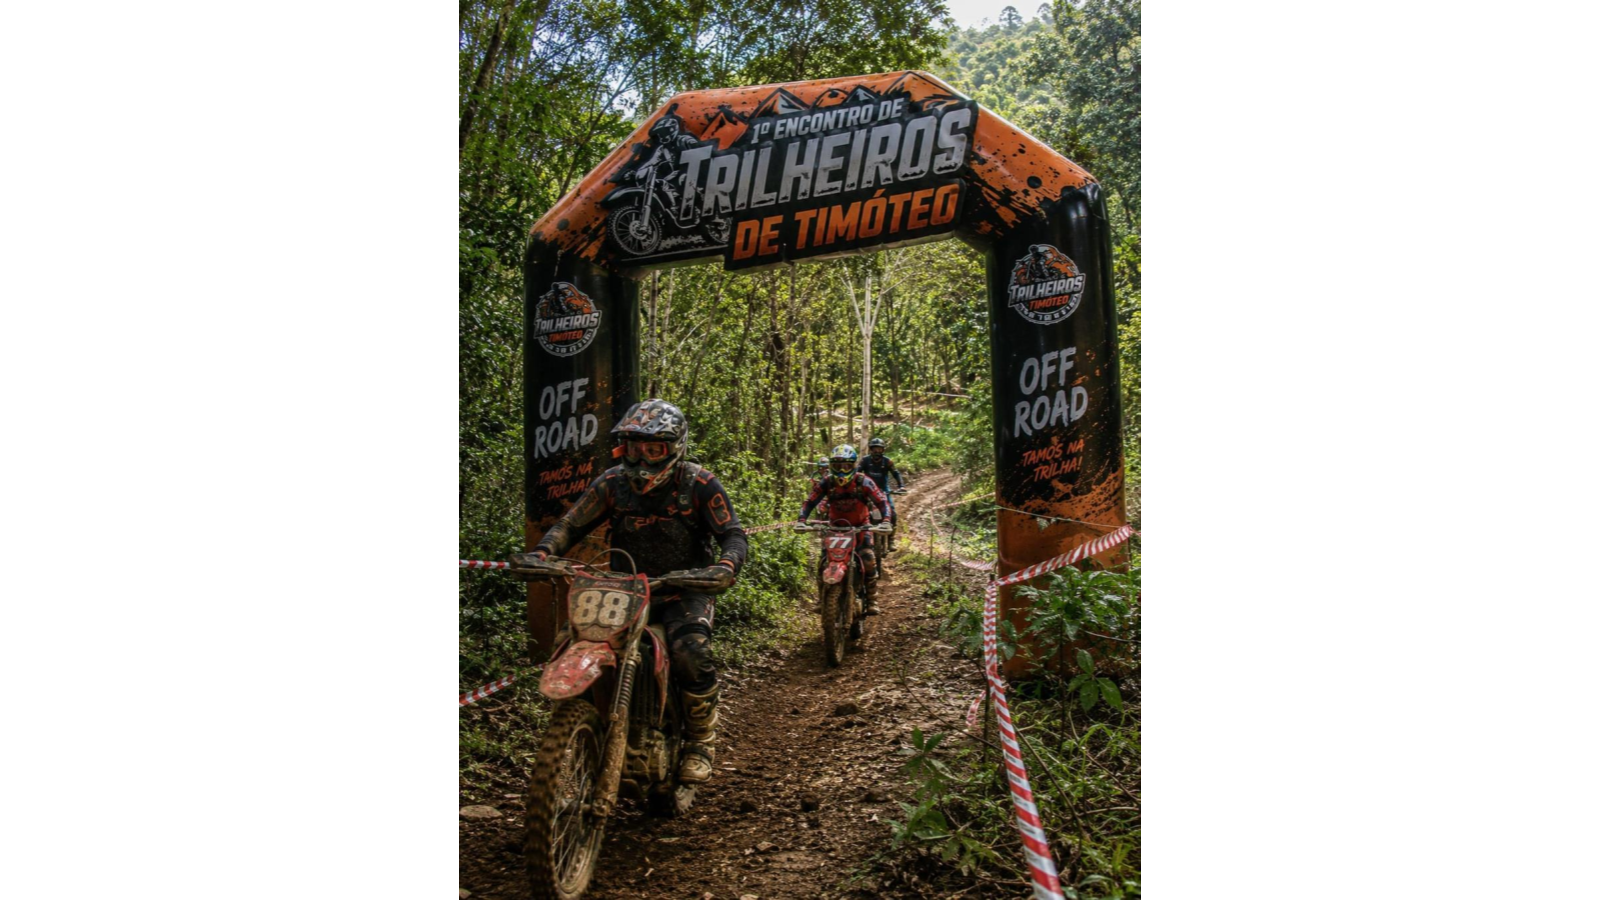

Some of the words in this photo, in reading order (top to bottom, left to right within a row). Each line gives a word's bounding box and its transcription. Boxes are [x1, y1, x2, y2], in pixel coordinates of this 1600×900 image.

[773, 101, 877, 141] ENCONTRO
[877, 98, 905, 122] DE
[678, 107, 972, 221] TRILHEIROS
[732, 215, 782, 261] DE
[794, 183, 960, 250] TIMÓTEO
[1010, 276, 1083, 302] TRILHEIROS
[535, 313, 599, 334] TRILHEIROS
[1019, 346, 1077, 395] OFF
[539, 377, 589, 420] OFF
[1014, 386, 1089, 438] ROAD
[534, 413, 598, 459] ROAD
[1067, 439, 1085, 454] NA
[576, 461, 593, 476] NA
[1033, 456, 1083, 483] TRILHA!
[546, 477, 591, 500] TRILHA!
[829, 537, 852, 549] 77
[573, 590, 630, 626] 88
